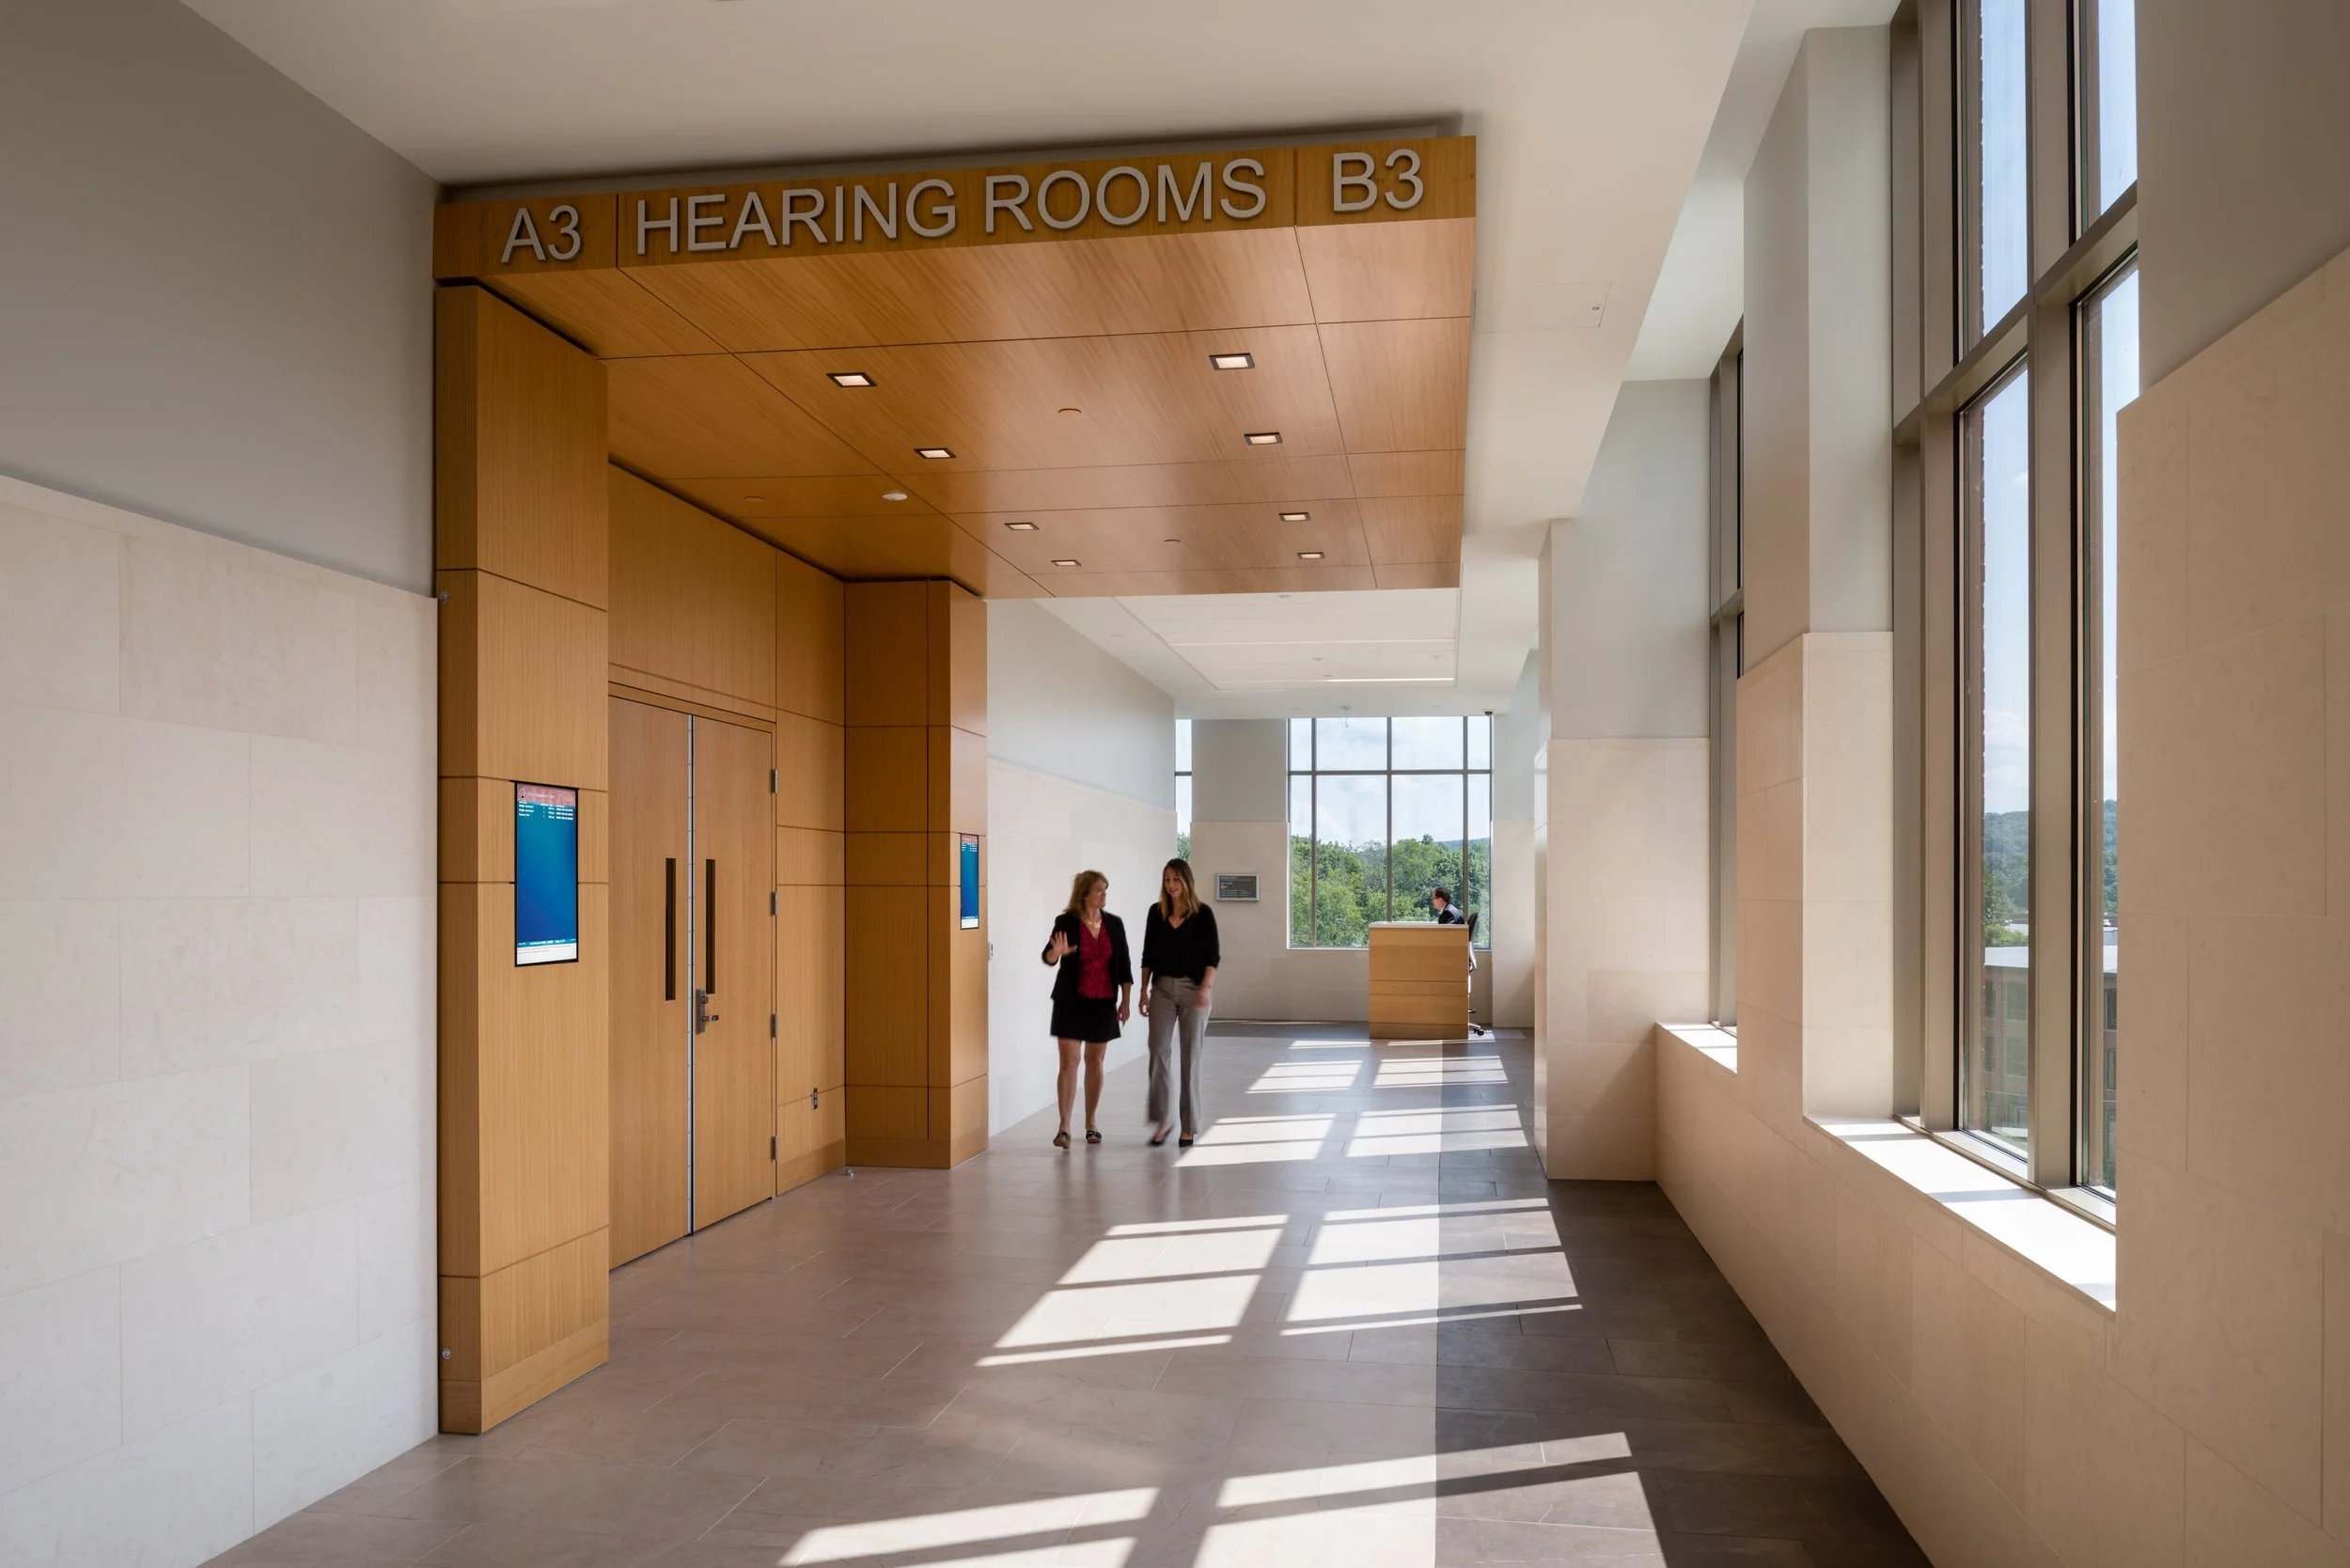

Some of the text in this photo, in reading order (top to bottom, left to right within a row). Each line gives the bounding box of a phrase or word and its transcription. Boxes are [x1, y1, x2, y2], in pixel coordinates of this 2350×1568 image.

[636, 157, 1266, 255] HEARING ROOMS
[1333, 149, 1423, 212] B3
[500, 205, 582, 263] A3
